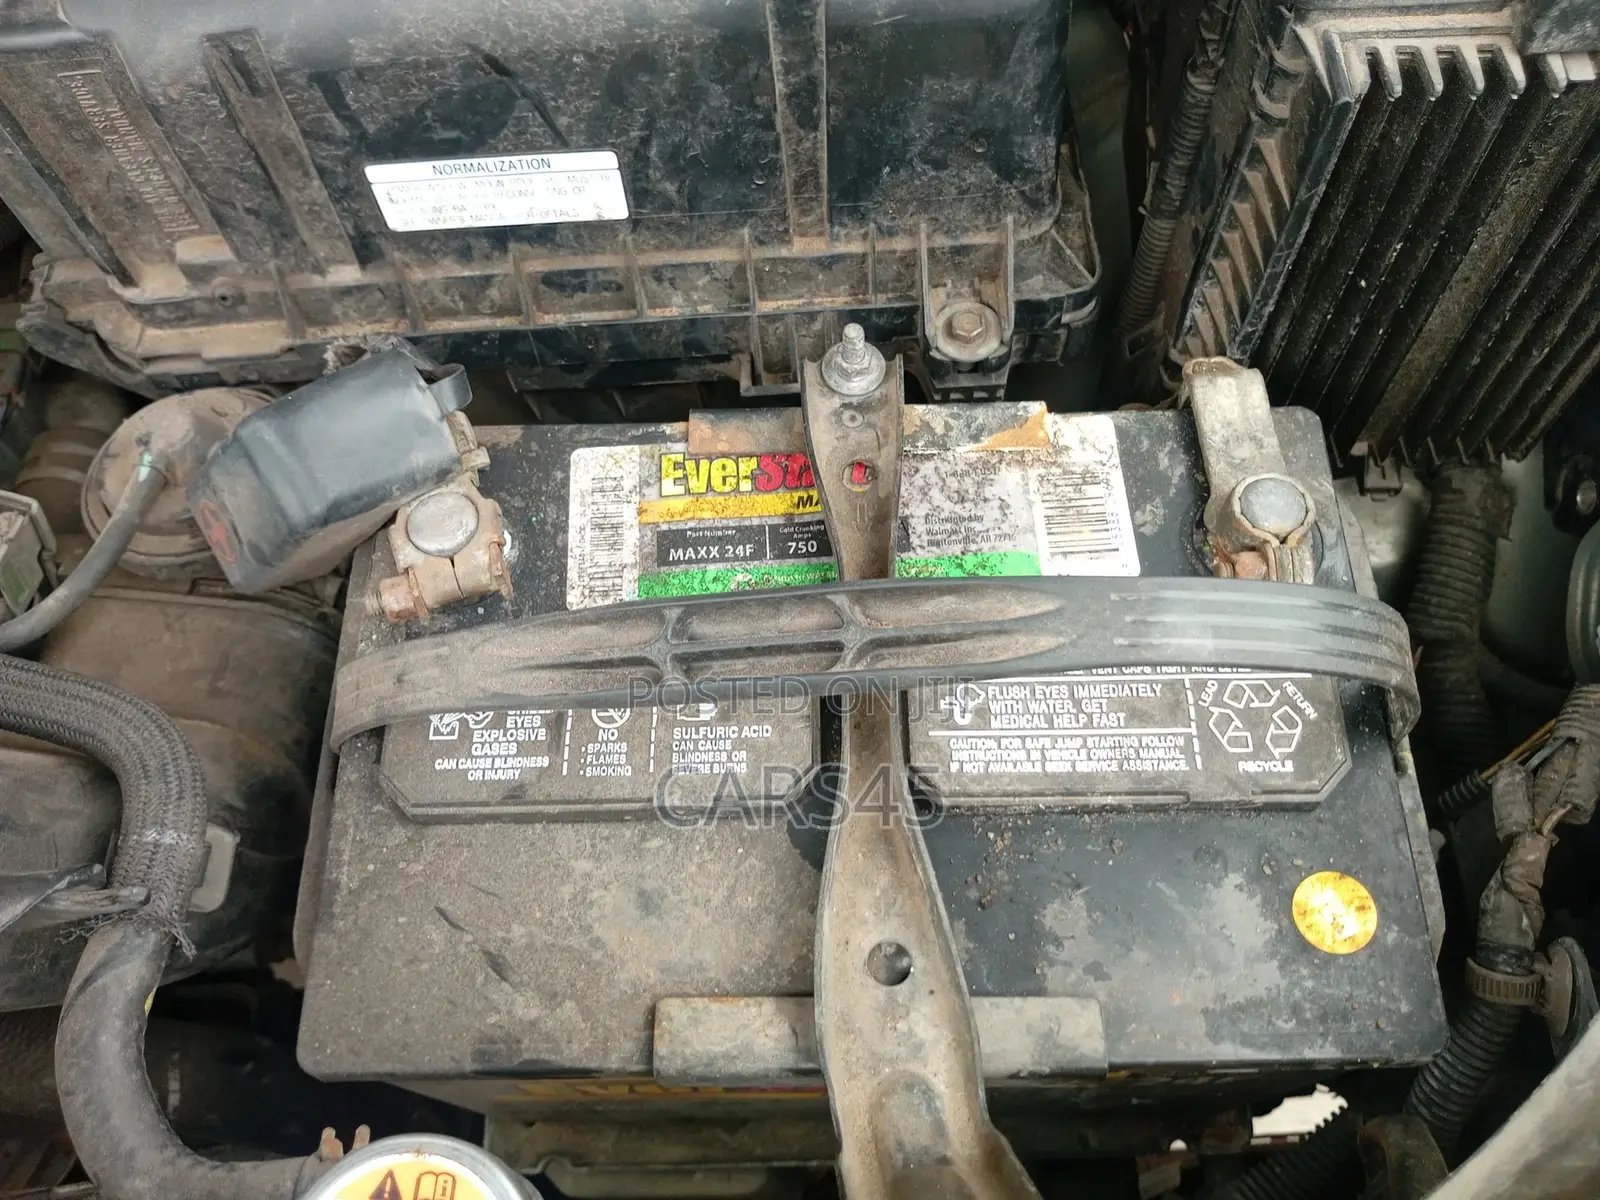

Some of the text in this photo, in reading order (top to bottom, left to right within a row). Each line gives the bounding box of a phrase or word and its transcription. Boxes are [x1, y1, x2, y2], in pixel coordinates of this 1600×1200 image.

[432, 157, 551, 176] NORMALIZATION
[669, 544, 755, 561] MAXX 24F
[787, 540, 818, 555] 750
[987, 683, 1162, 700] FLUSH EYES IMMEDIATELY
[1197, 680, 1219, 708] LEAD
[988, 700, 1023, 714] WITH
[1081, 699, 1109, 713] GET
[1282, 680, 1319, 720] RETURN
[506, 715, 541, 728] EYES
[990, 712, 1127, 729] MEDICAL HELP FAST
[473, 728, 547, 742] EXPLOSIVE
[597, 728, 619, 742] NO
[672, 725, 772, 740] SULFURIC ACID
[471, 742, 518, 756] GASES
[587, 742, 628, 754] SPARKS
[672, 739, 732, 751] CAN CAUSE
[1000, 737, 1023, 749] FOR
[1025, 736, 1050, 749] SAFE
[1054, 736, 1083, 749] JUMP
[1086, 735, 1138, 748] STARTING
[1141, 735, 1185, 747] FOLLOW
[586, 753, 627, 765] FLAMES
[672, 750, 747, 763] BLINDNESS OR
[951, 749, 1027, 761] INSTRUCTIONS
[1030, 749, 1041, 761] IN
[1044, 748, 1088, 761] VEHICLE
[434, 756, 550, 770] CAN CAUSE BLINDNESS
[672, 762, 748, 775] SEVERE BURNS
[950, 759, 1190, 773] IF NOT AVAILABLE SEEK SERVICE ASSISTANCE.
[1238, 759, 1294, 772] RECYCLE
[467, 768, 521, 781] OR INJURY
[585, 765, 632, 777] SMOKING
